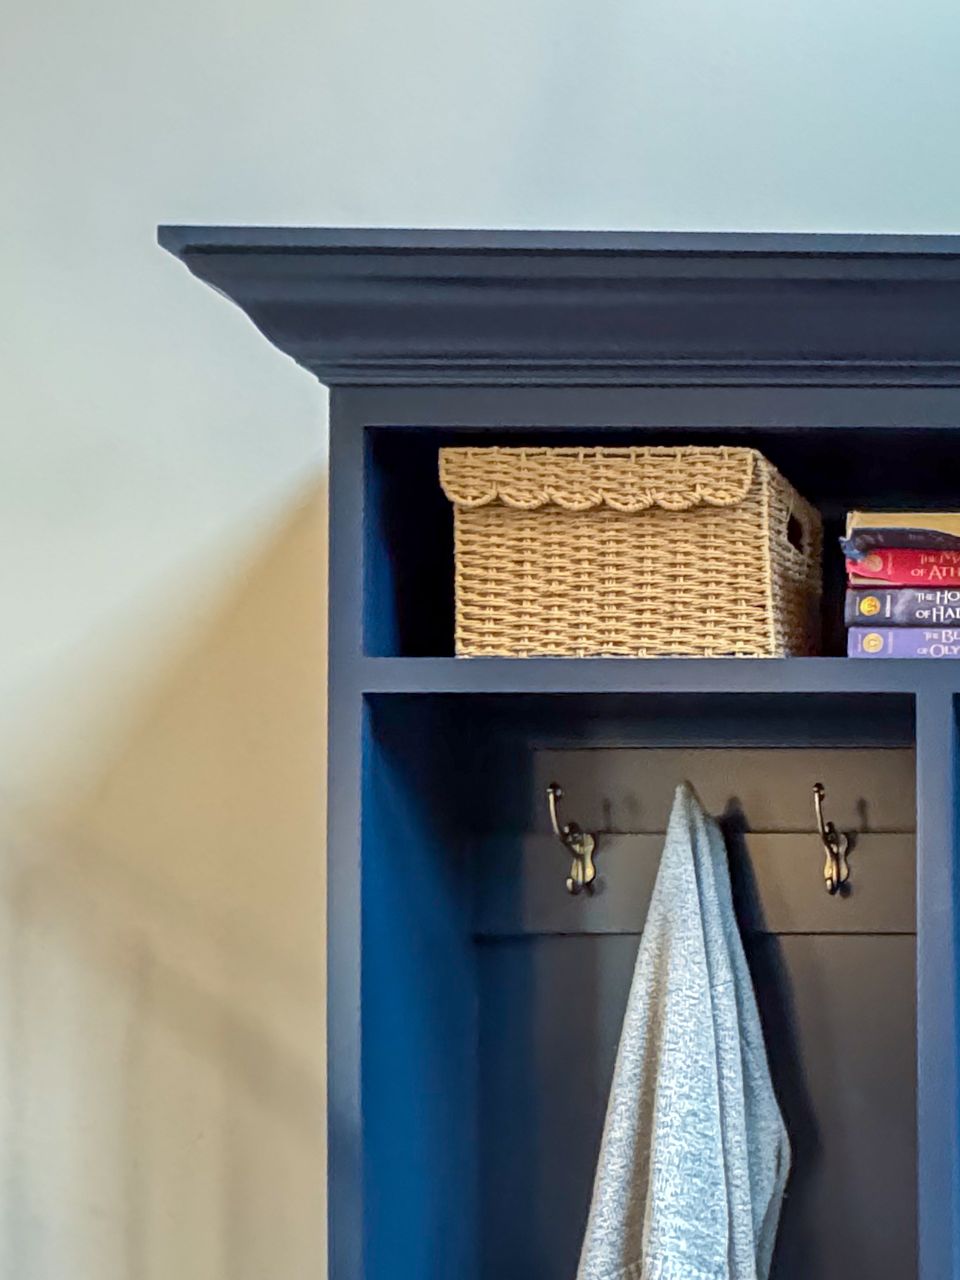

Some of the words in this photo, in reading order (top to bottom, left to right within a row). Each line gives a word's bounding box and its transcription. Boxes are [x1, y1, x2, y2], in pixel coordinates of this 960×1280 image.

[920, 553, 935, 565] THE
[910, 568, 928, 577] OF
[915, 592, 935, 603] THE
[915, 609, 931, 619] OF
[923, 631, 939, 641] THE
[916, 647, 928, 655] OF
